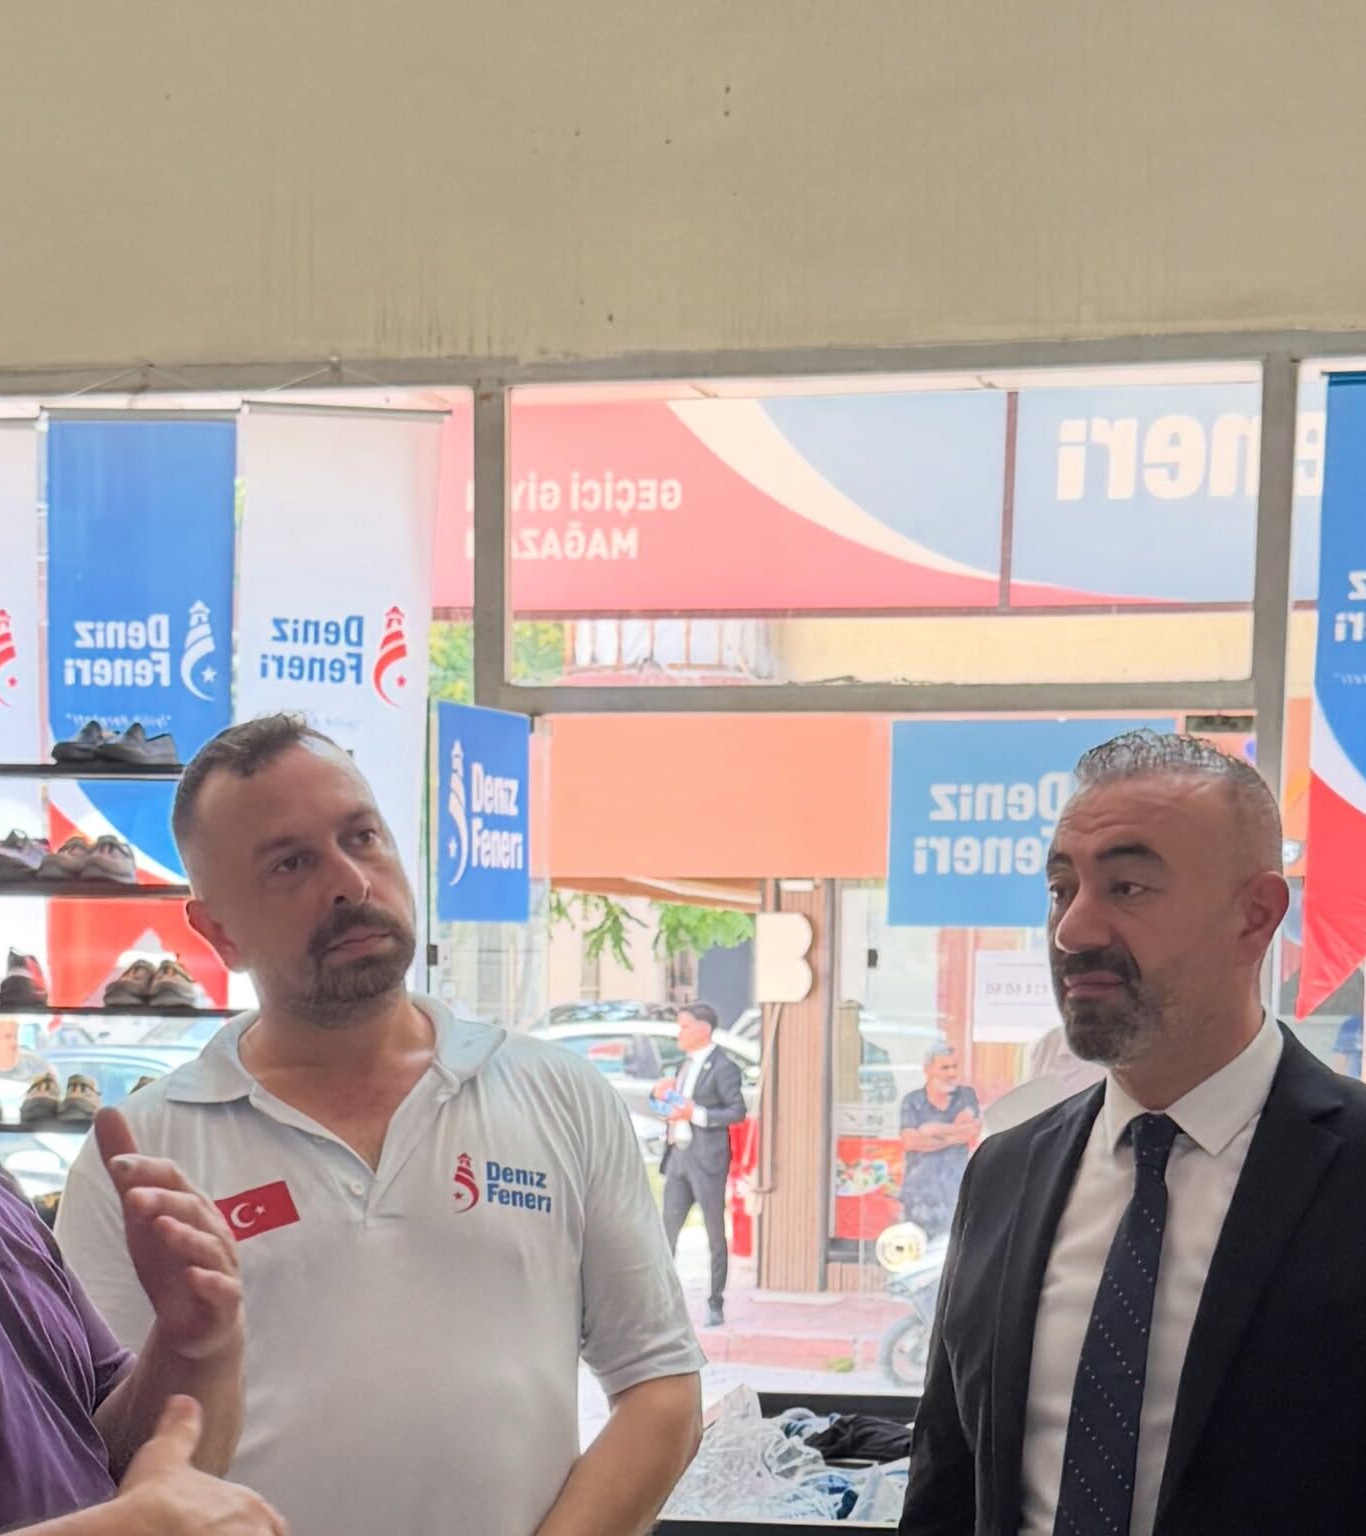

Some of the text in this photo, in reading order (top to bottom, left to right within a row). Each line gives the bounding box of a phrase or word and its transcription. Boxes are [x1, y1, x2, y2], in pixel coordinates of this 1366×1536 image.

[471, 762, 518, 816] Deniz
[471, 817, 523, 870] Feneri
[486, 1161, 547, 1189] Deniz
[487, 1183, 551, 1214] Feneri
